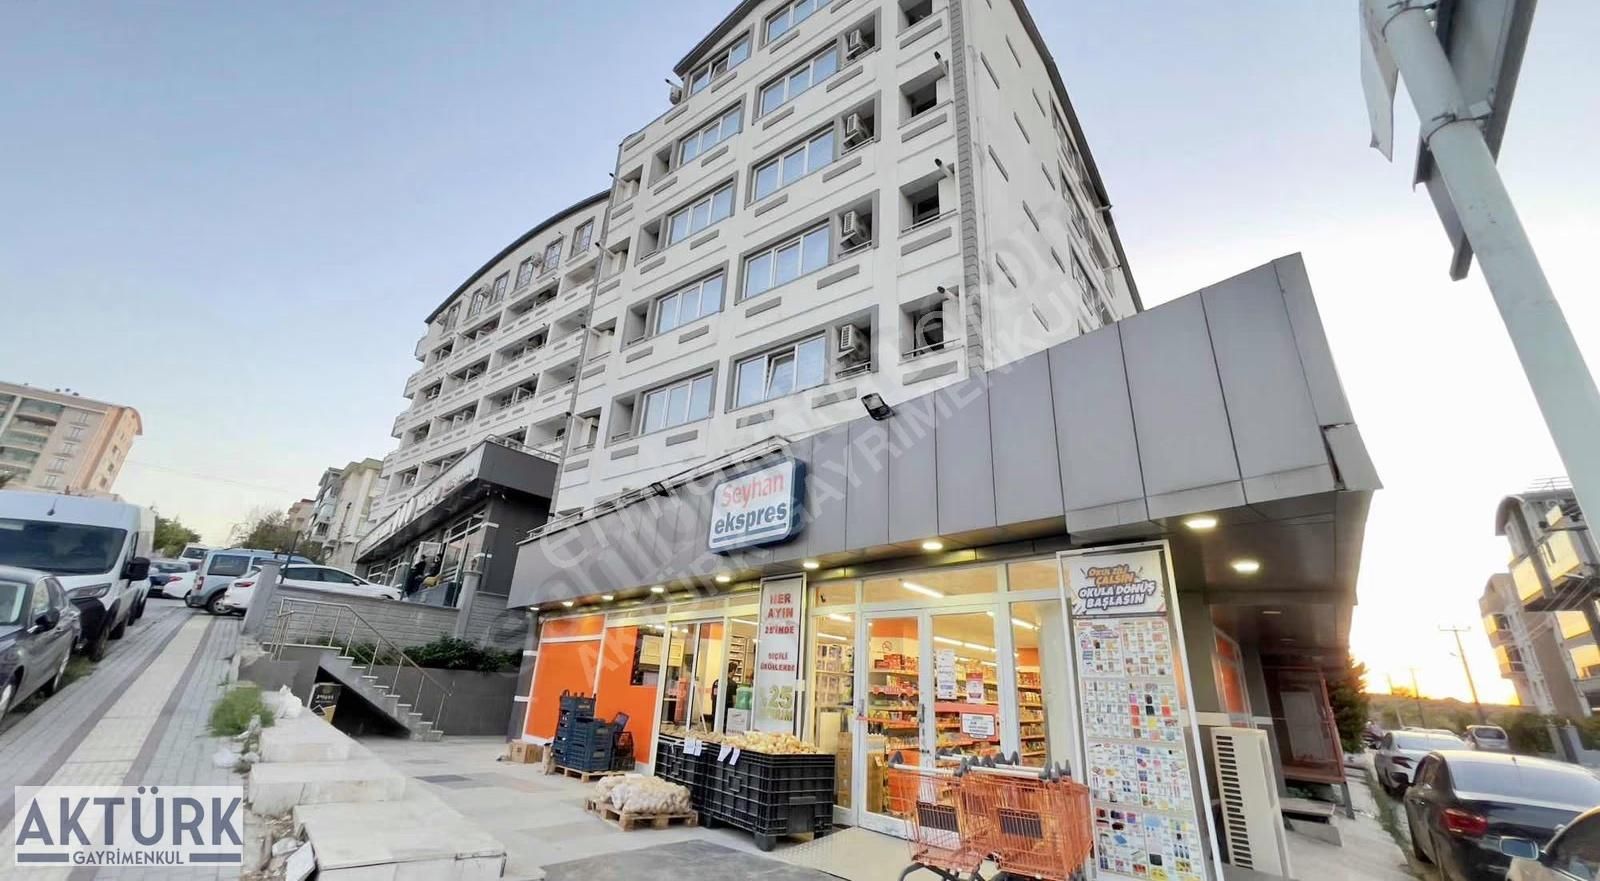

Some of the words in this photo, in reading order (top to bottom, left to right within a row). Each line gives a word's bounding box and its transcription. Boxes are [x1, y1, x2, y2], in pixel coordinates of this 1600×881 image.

[721, 473, 784, 508] Seyhan
[714, 502, 787, 535] ekspres
[1079, 586, 1113, 598] OKULA
[1115, 580, 1156, 595] DÖNÜŞ
[770, 592, 791, 604] HER
[1086, 594, 1145, 610] BAŞLASIN
[767, 607, 793, 619] AYIN
